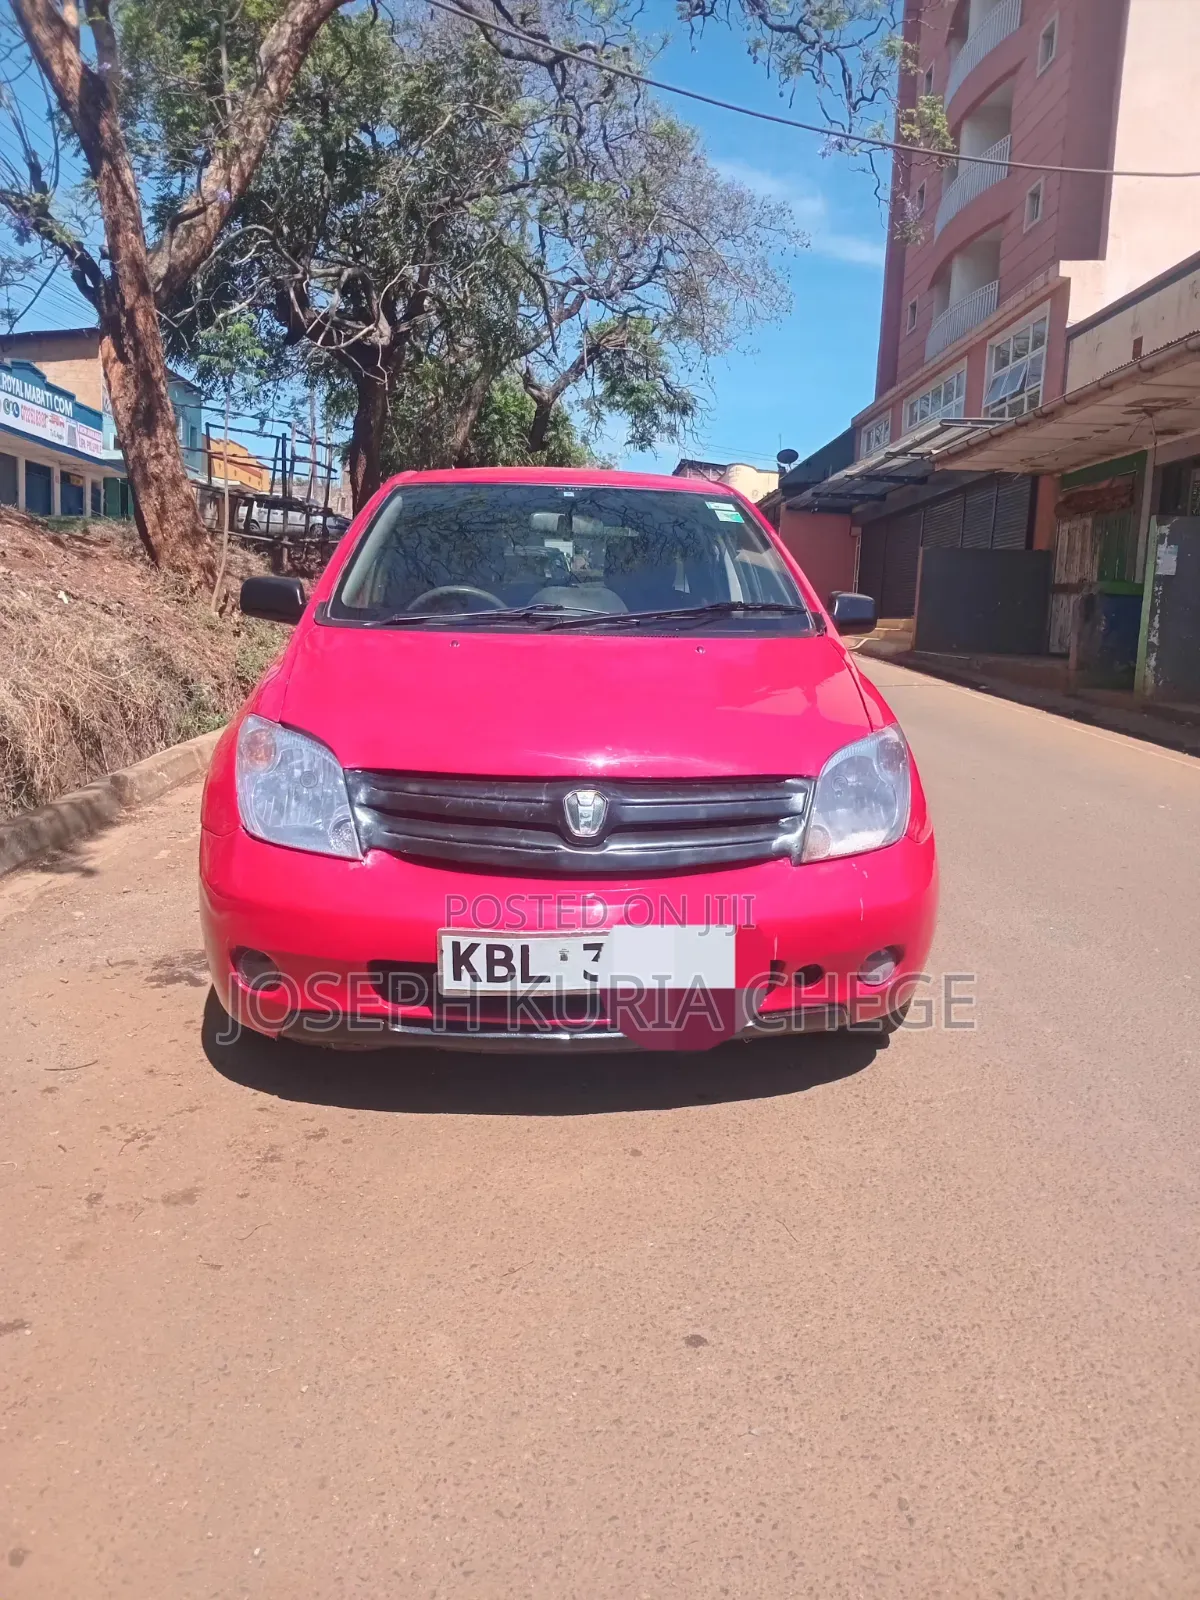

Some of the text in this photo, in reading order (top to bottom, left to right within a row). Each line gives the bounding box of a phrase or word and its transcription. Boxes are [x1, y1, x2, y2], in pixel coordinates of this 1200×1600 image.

[1, 373, 24, 397] ROYAL
[24, 382, 53, 410] MABATI
[54, 395, 73, 418] COM
[452, 941, 550, 984] KBL
